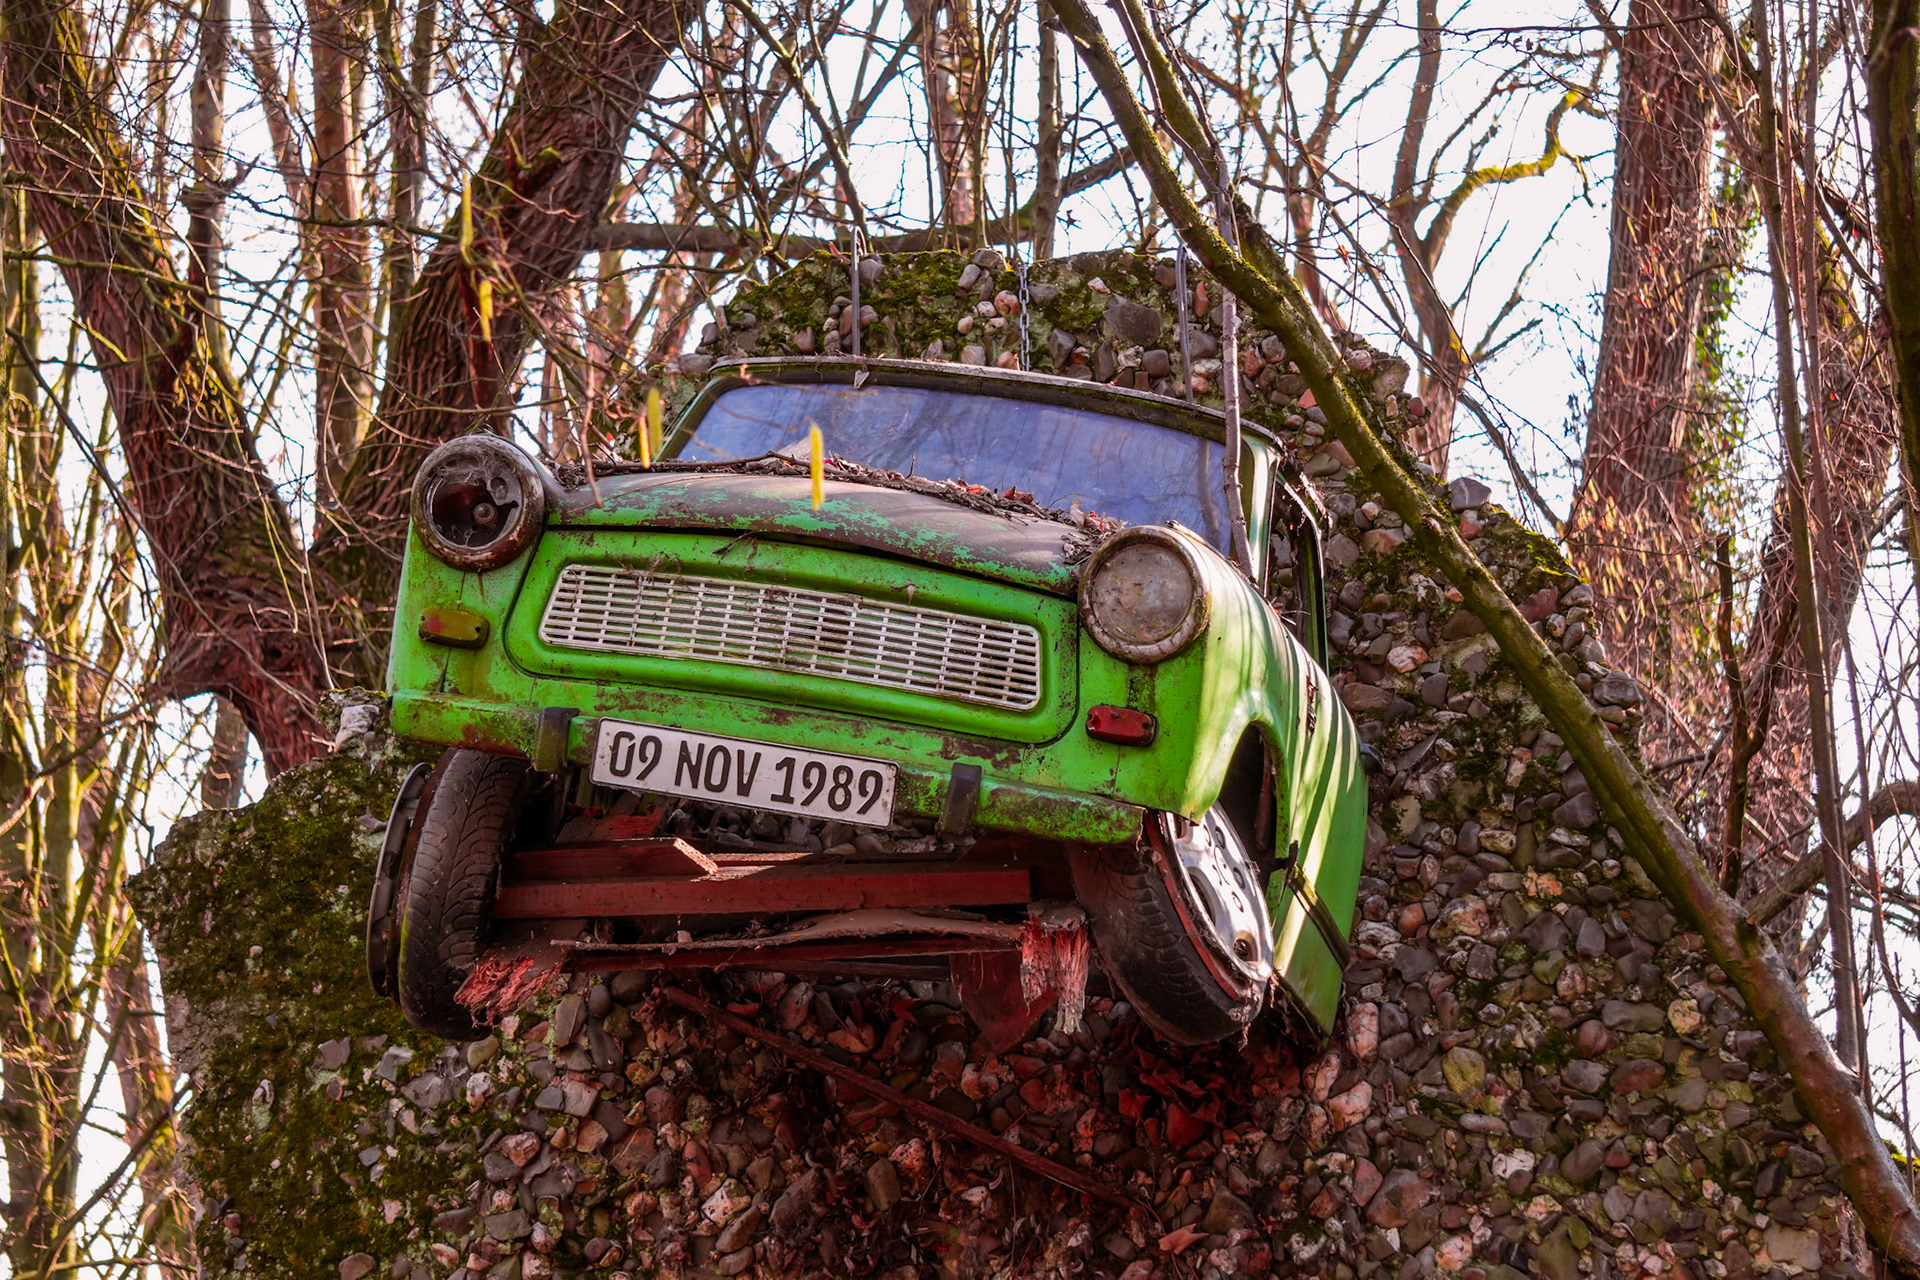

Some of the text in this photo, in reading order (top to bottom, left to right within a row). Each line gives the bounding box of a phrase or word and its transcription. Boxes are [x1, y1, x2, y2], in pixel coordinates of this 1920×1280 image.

[609, 731, 883, 815] 09 NOV 1989
